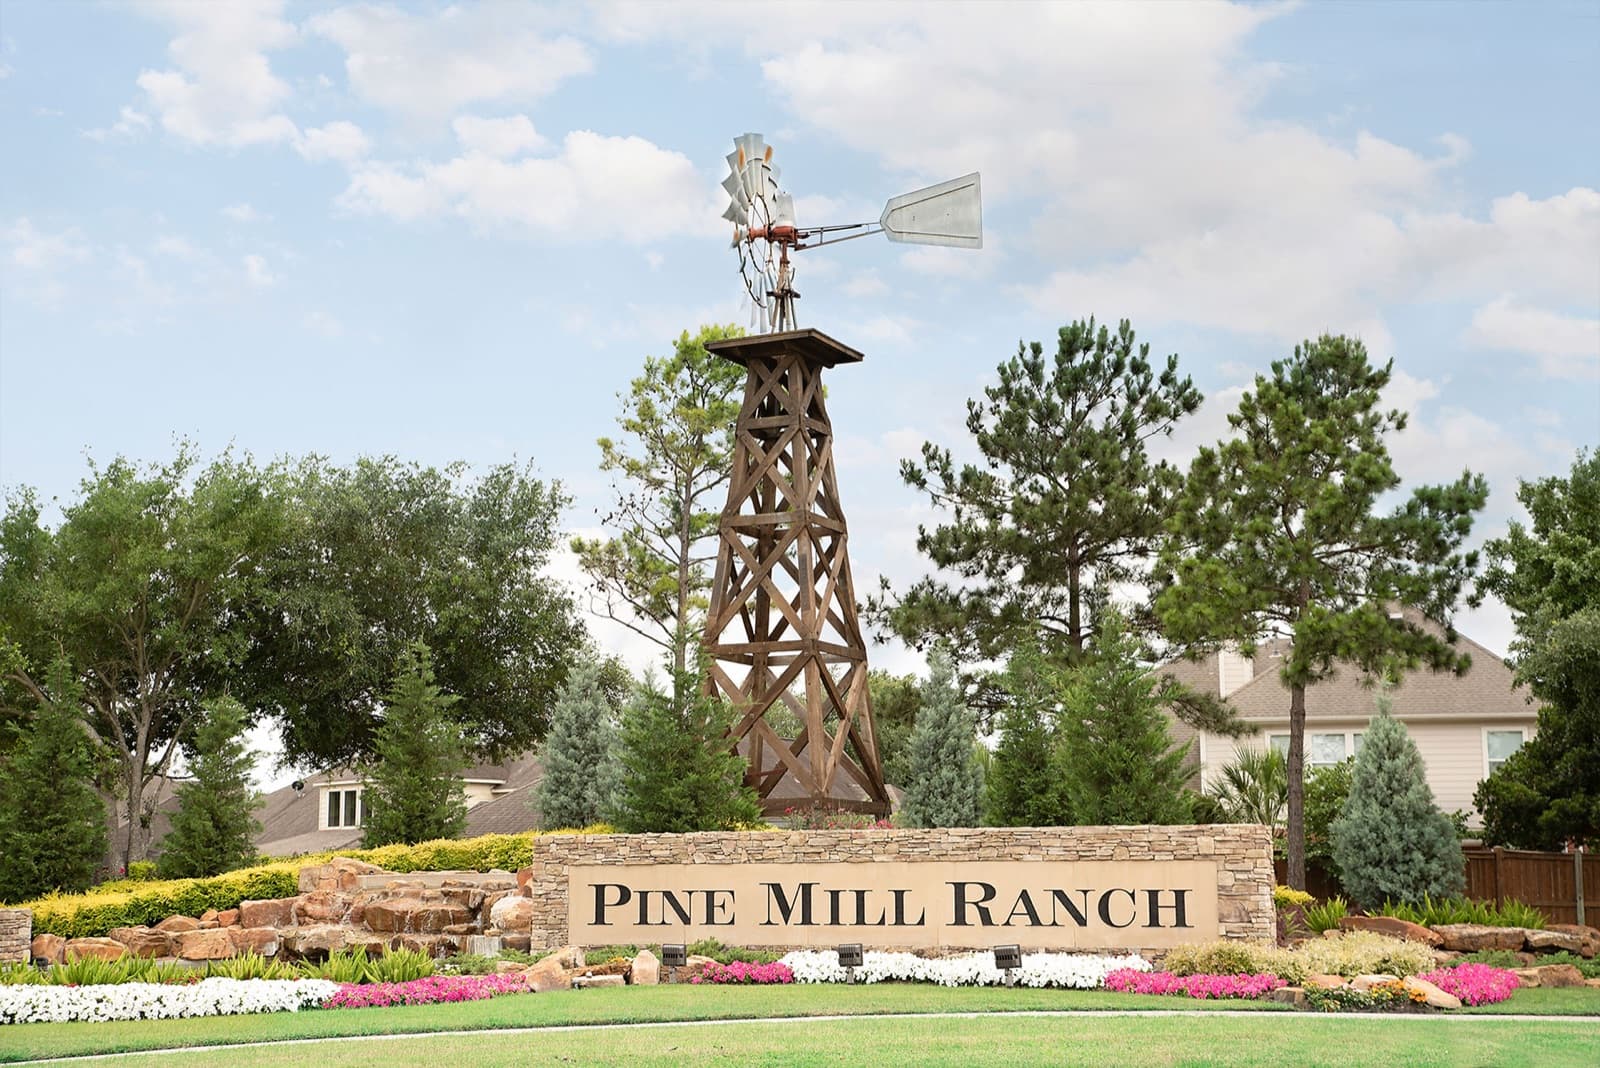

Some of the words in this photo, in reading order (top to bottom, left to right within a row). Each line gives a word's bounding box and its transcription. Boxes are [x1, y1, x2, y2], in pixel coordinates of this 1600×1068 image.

[587, 883, 736, 926] PINE
[759, 882, 925, 926] MILL
[945, 881, 1194, 928] RANCH
